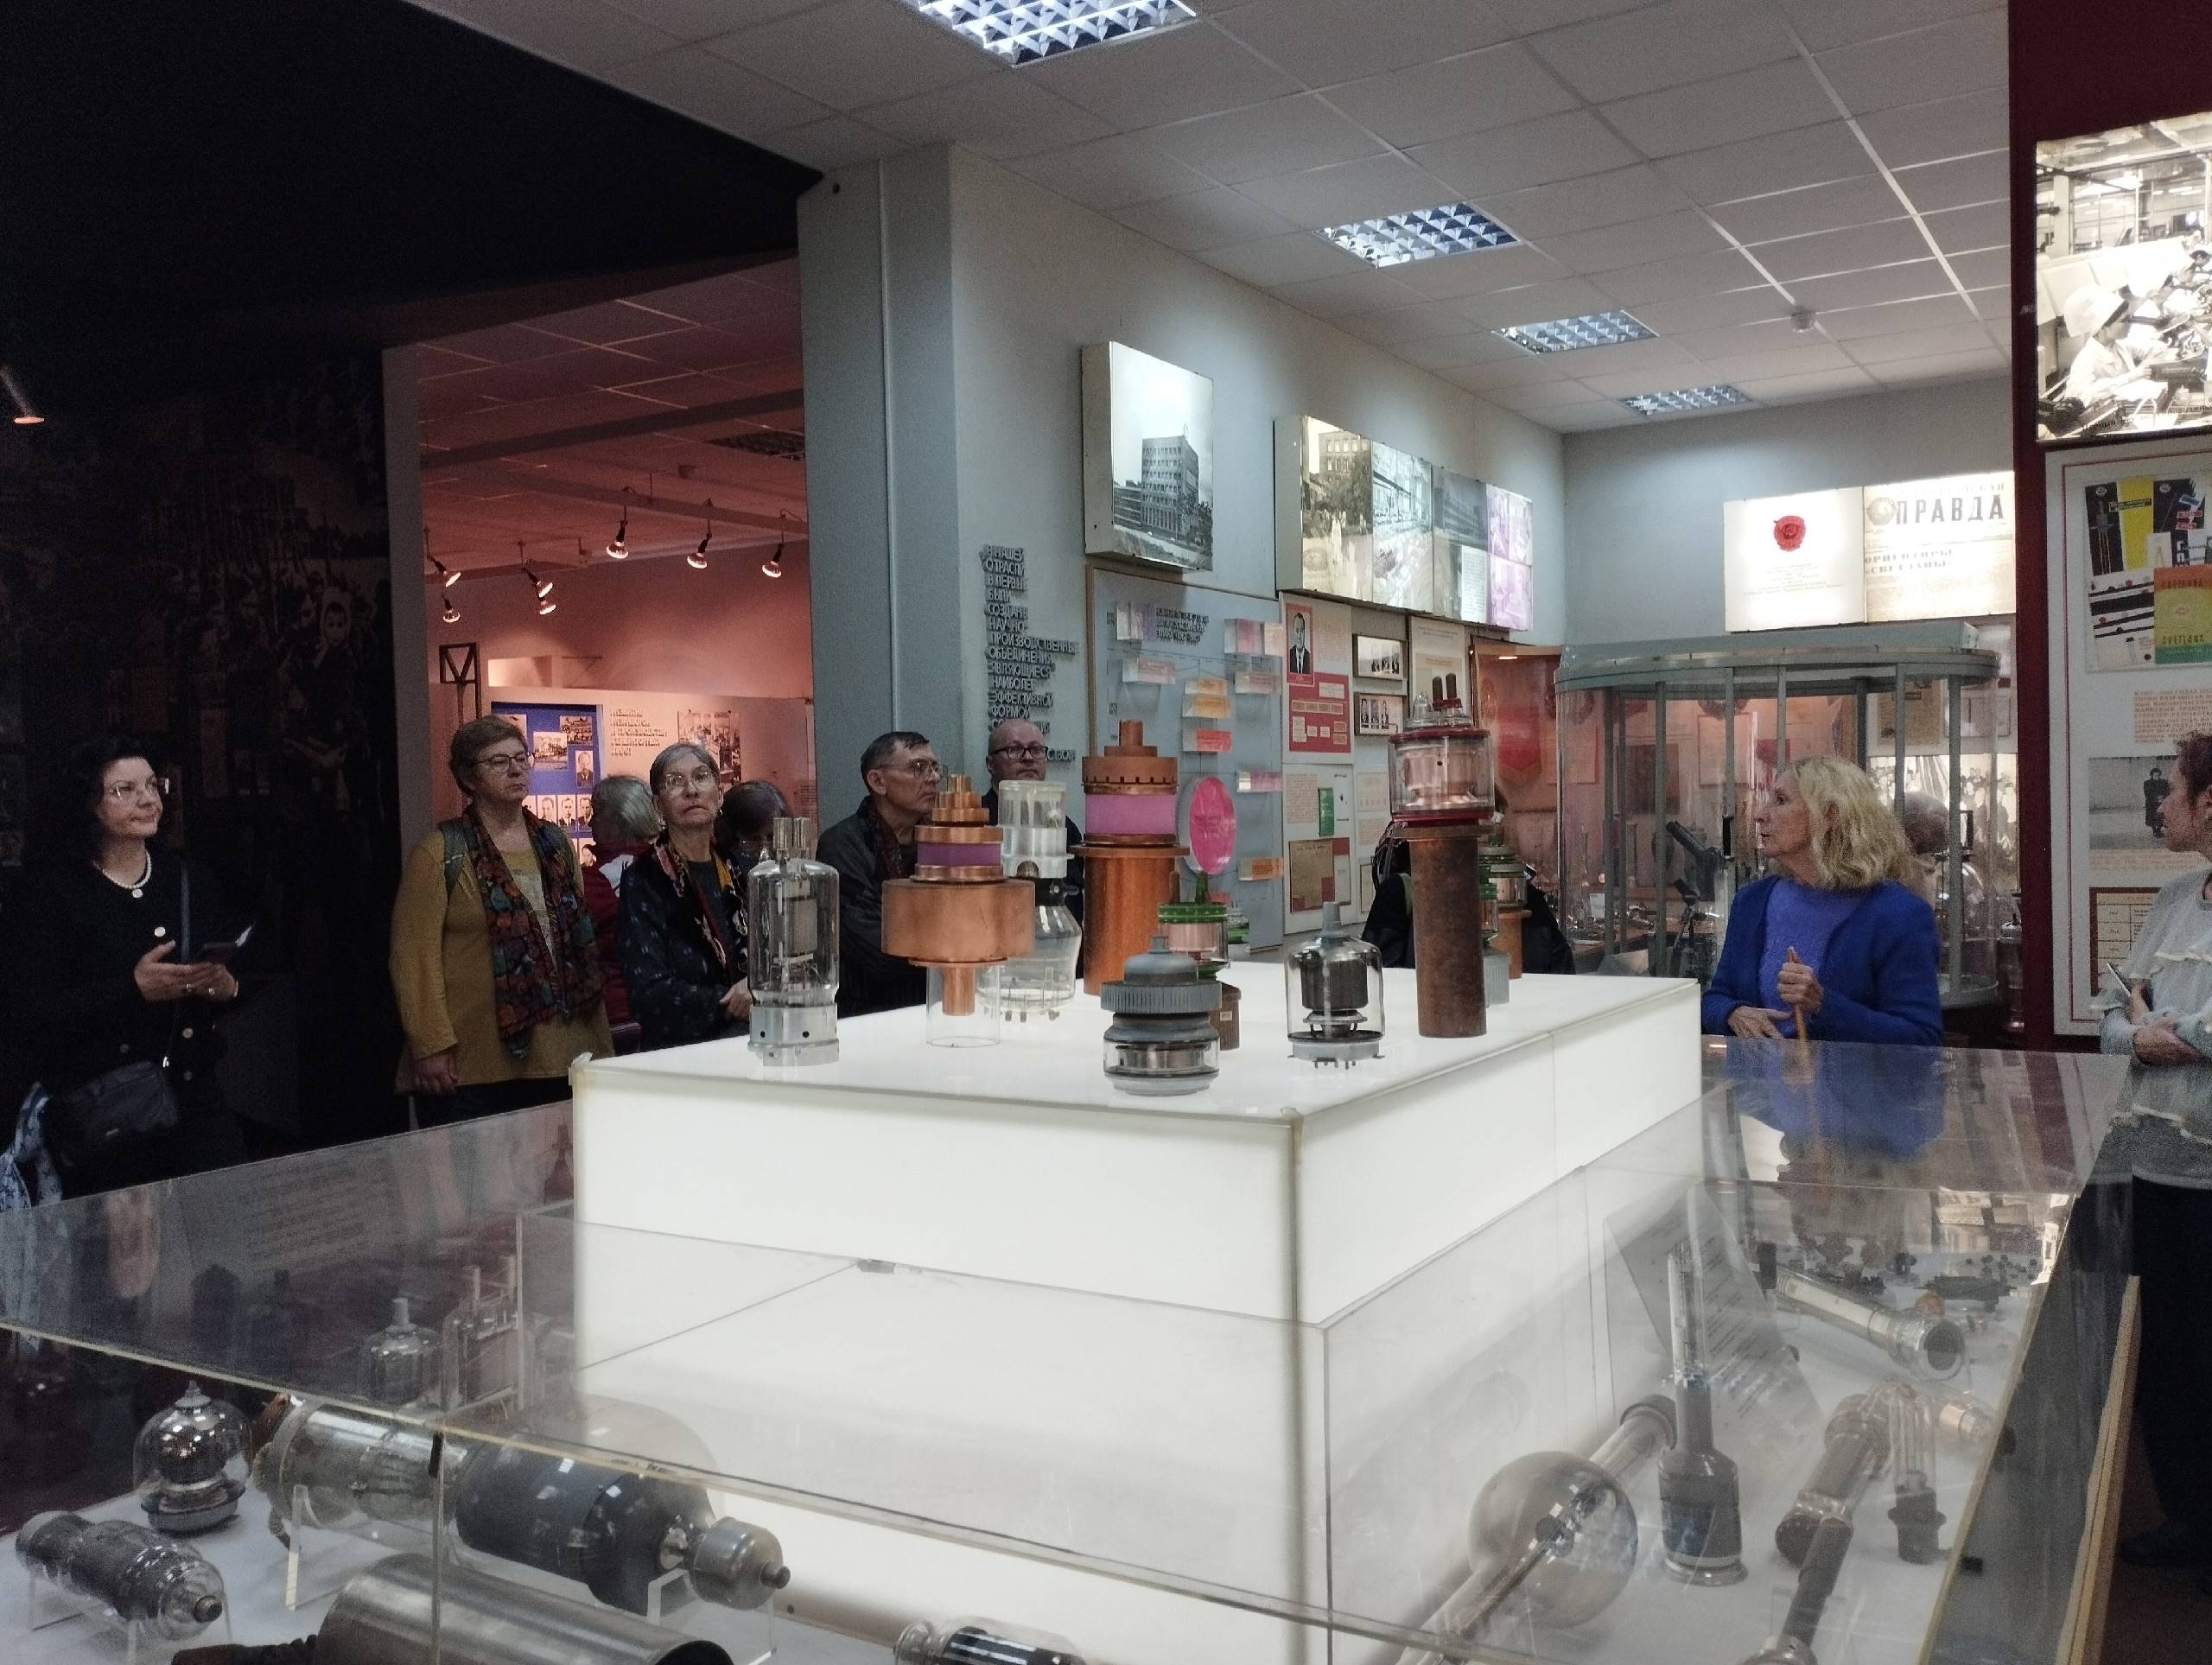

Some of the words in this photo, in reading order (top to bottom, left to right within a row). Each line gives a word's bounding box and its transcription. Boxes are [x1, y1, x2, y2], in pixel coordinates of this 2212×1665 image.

[1897, 494, 2005, 524] ПРАВДА
[995, 547, 1024, 562] НАШЕЙ
[986, 559, 1024, 576] ОТРАСЛИ
[988, 588, 1010, 602] БЫЛИ
[988, 603, 1028, 620] СОЗДАНЫ
[991, 632, 1079, 654] ПРОИЗВОДСТВЕННЫЕ
[991, 662, 1052, 678] ЯВЛЯЮЩИЕСЯ
[992, 676, 1036, 691] НАИБОЛЕЕ
[992, 691, 1053, 708] ЭФФЕКТИВНОЙ
[992, 705, 1030, 719] ФОРМОЙ
